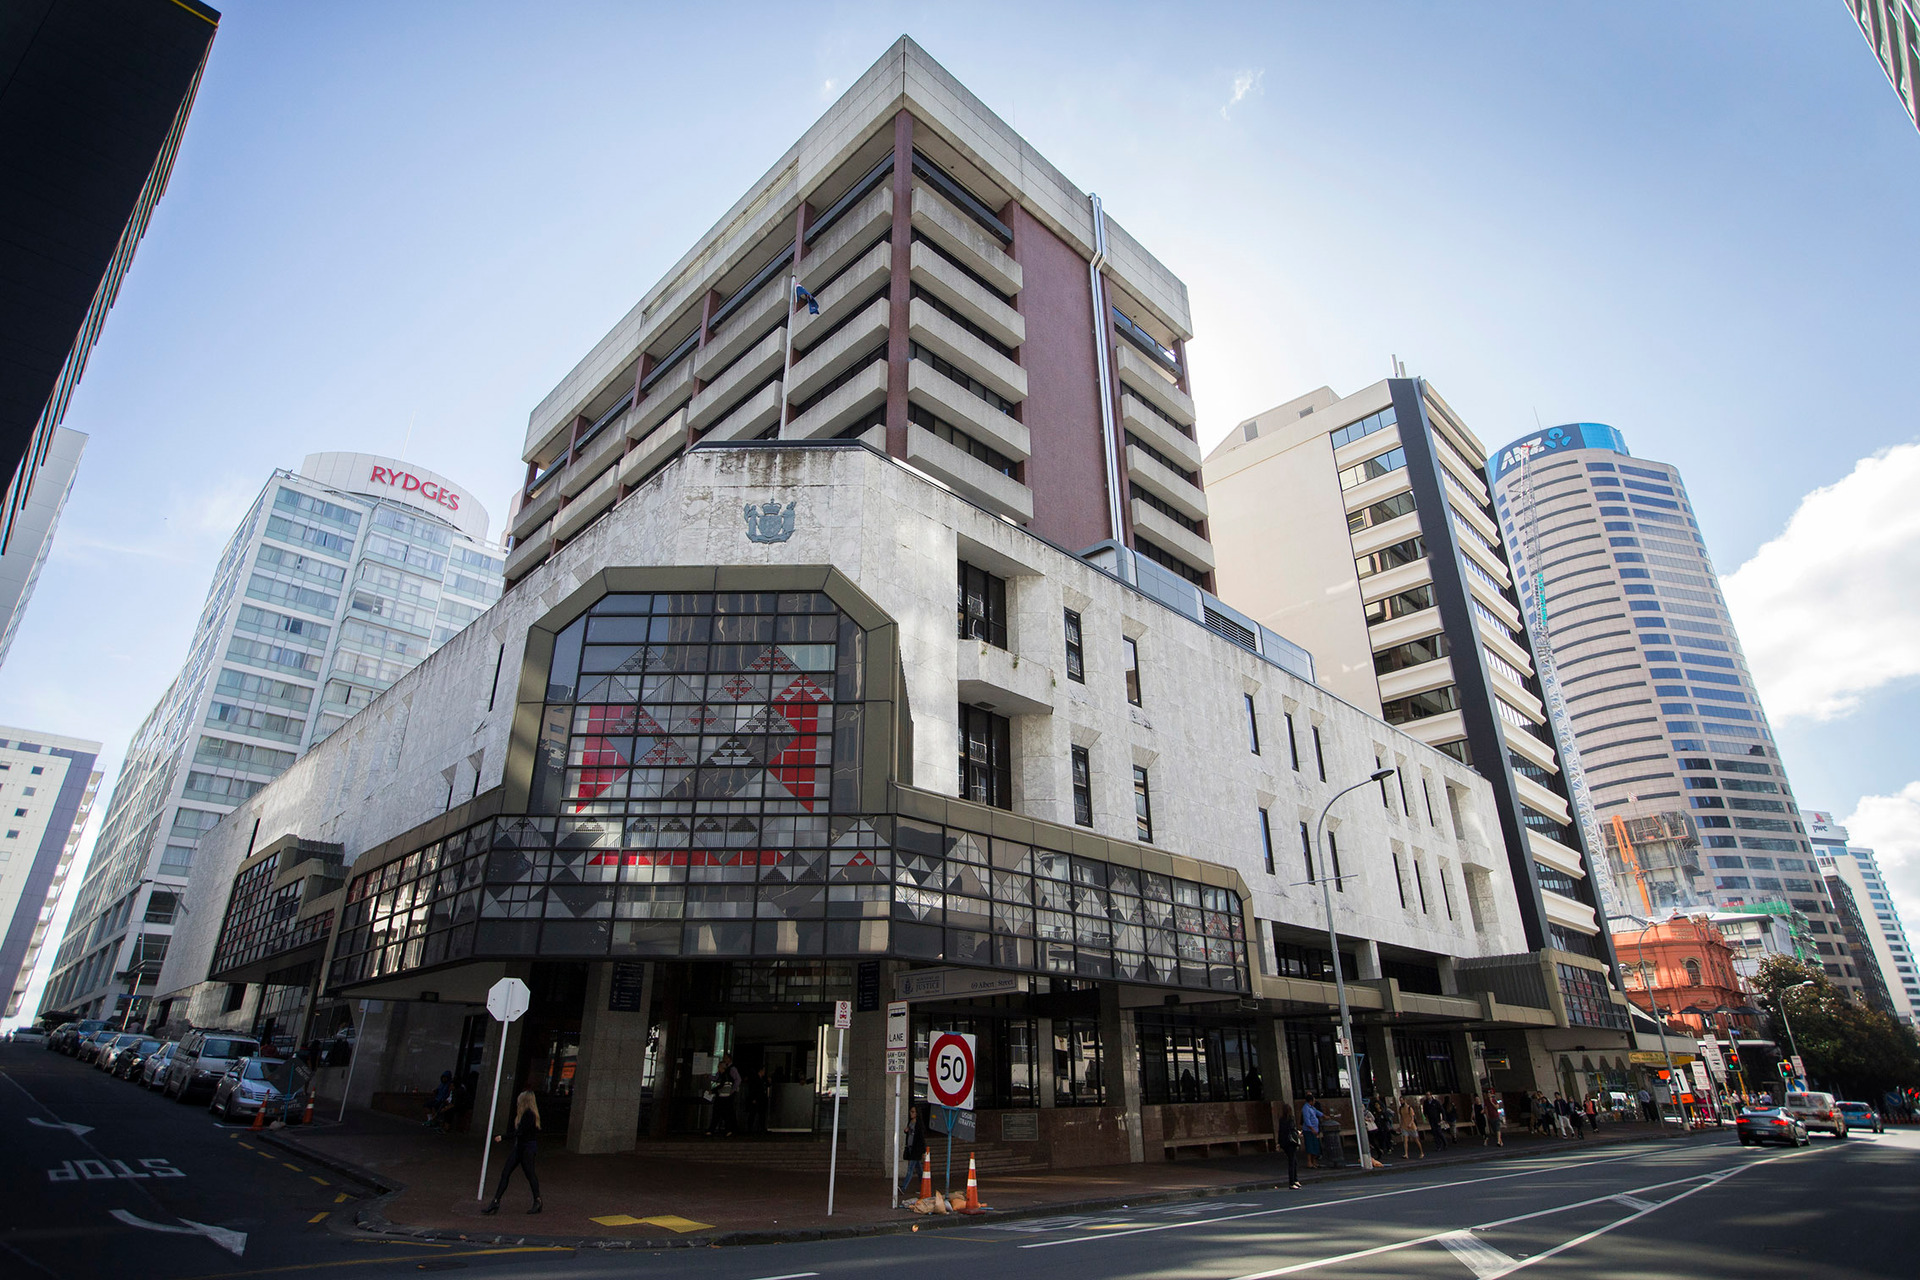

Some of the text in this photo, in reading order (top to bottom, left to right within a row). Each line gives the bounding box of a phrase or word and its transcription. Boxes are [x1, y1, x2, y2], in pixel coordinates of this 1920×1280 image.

[1501, 437, 1546, 471] ANZ
[370, 465, 460, 511] RYDGES
[916, 981, 939, 992] JUSTICE
[889, 1033, 904, 1043] LANE
[940, 1055, 964, 1083] 50
[47, 1158, 187, 1182] STOP
